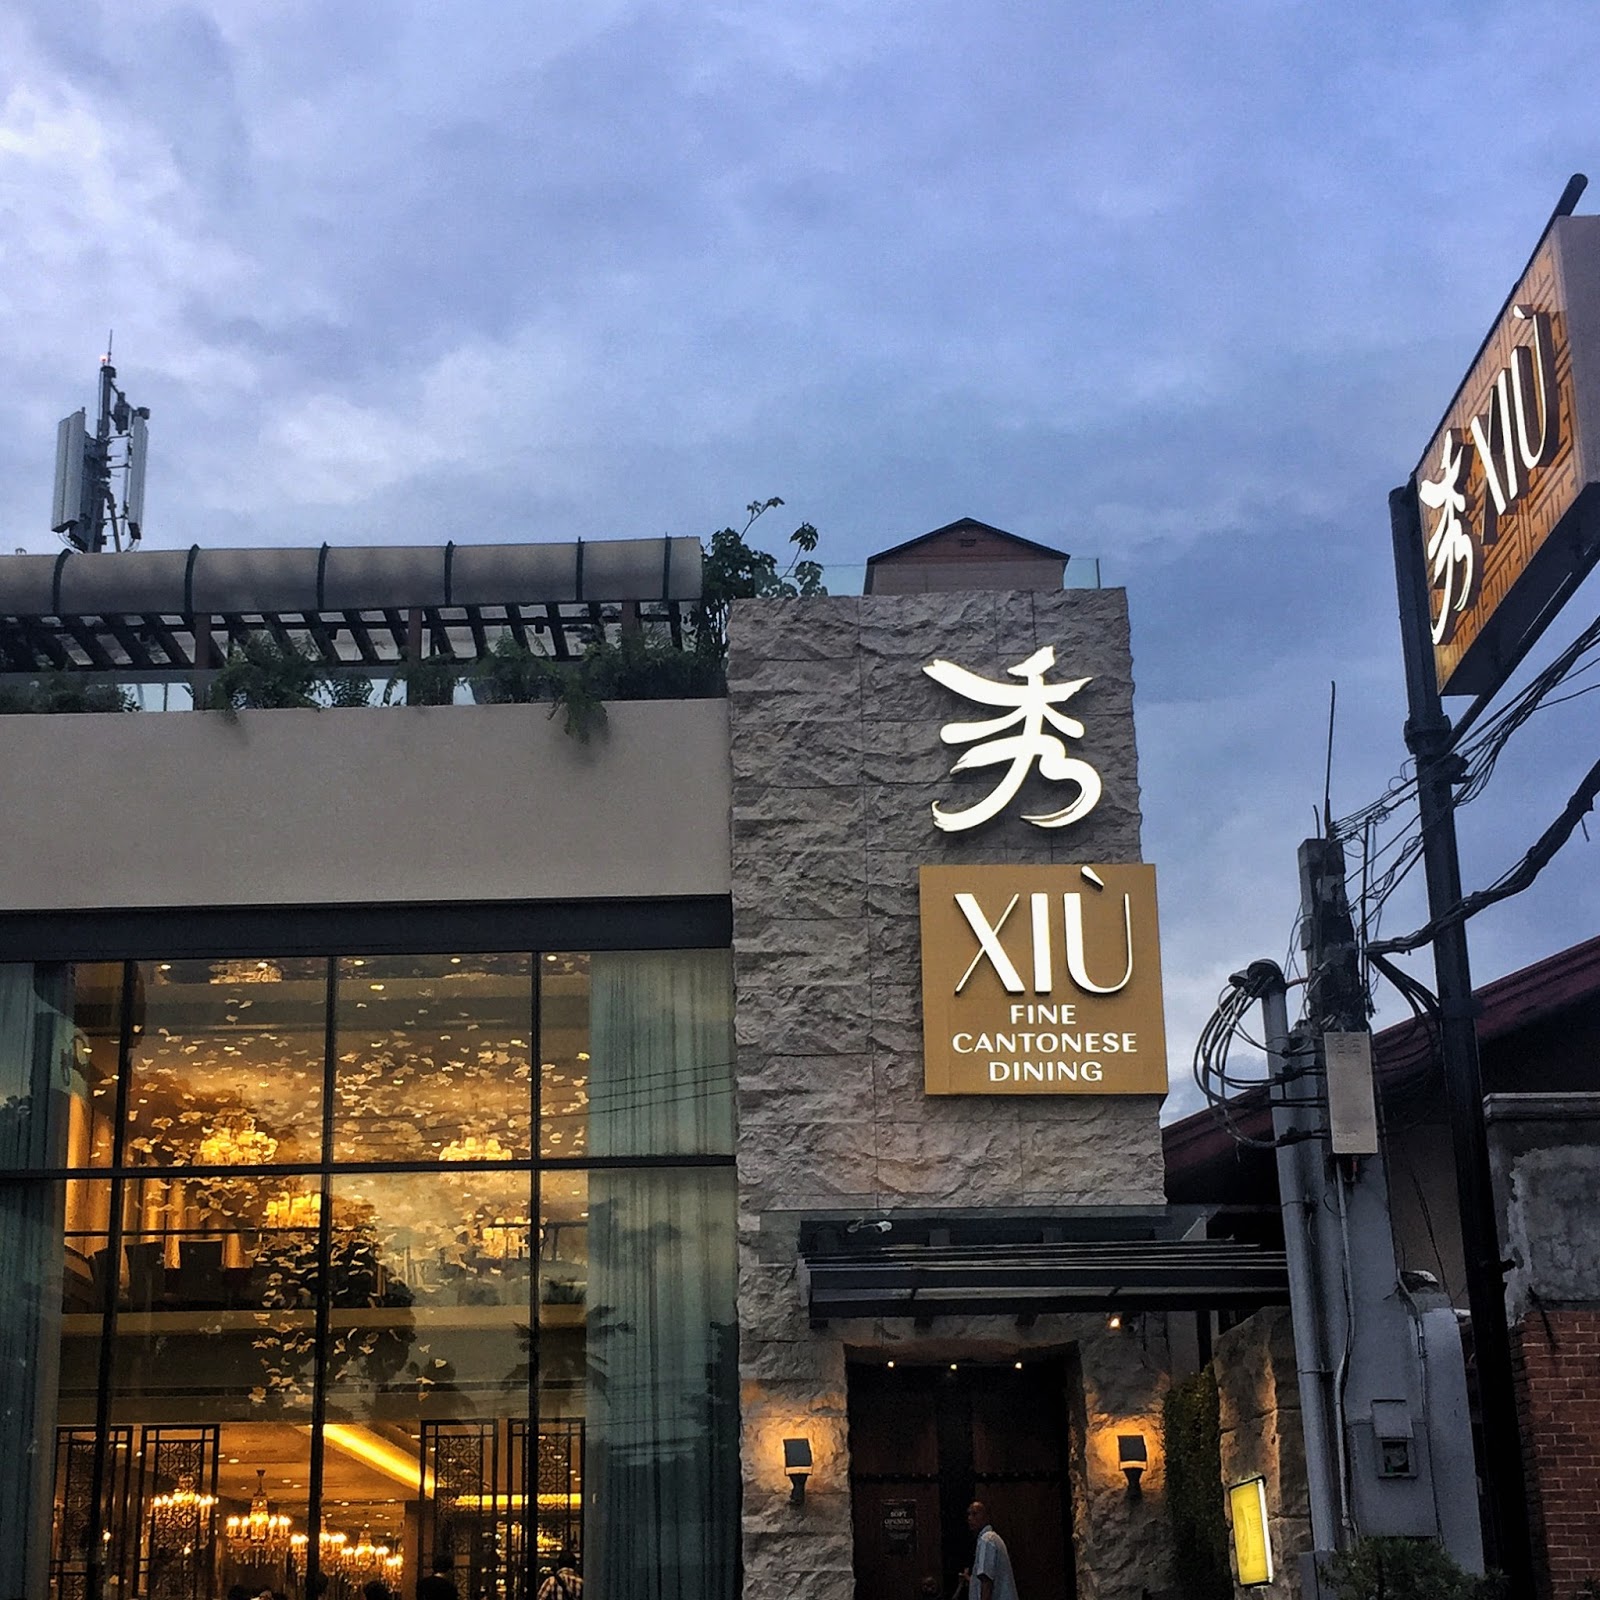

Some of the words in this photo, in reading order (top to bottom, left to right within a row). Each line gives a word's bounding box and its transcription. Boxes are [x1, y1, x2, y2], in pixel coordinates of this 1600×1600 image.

[922, 645, 1102, 832] 秀
[954, 865, 1133, 993] XIÙ
[1010, 1004, 1077, 1025] FINE
[952, 1032, 1137, 1054] CANTONESE
[989, 1061, 1103, 1082] DINING
